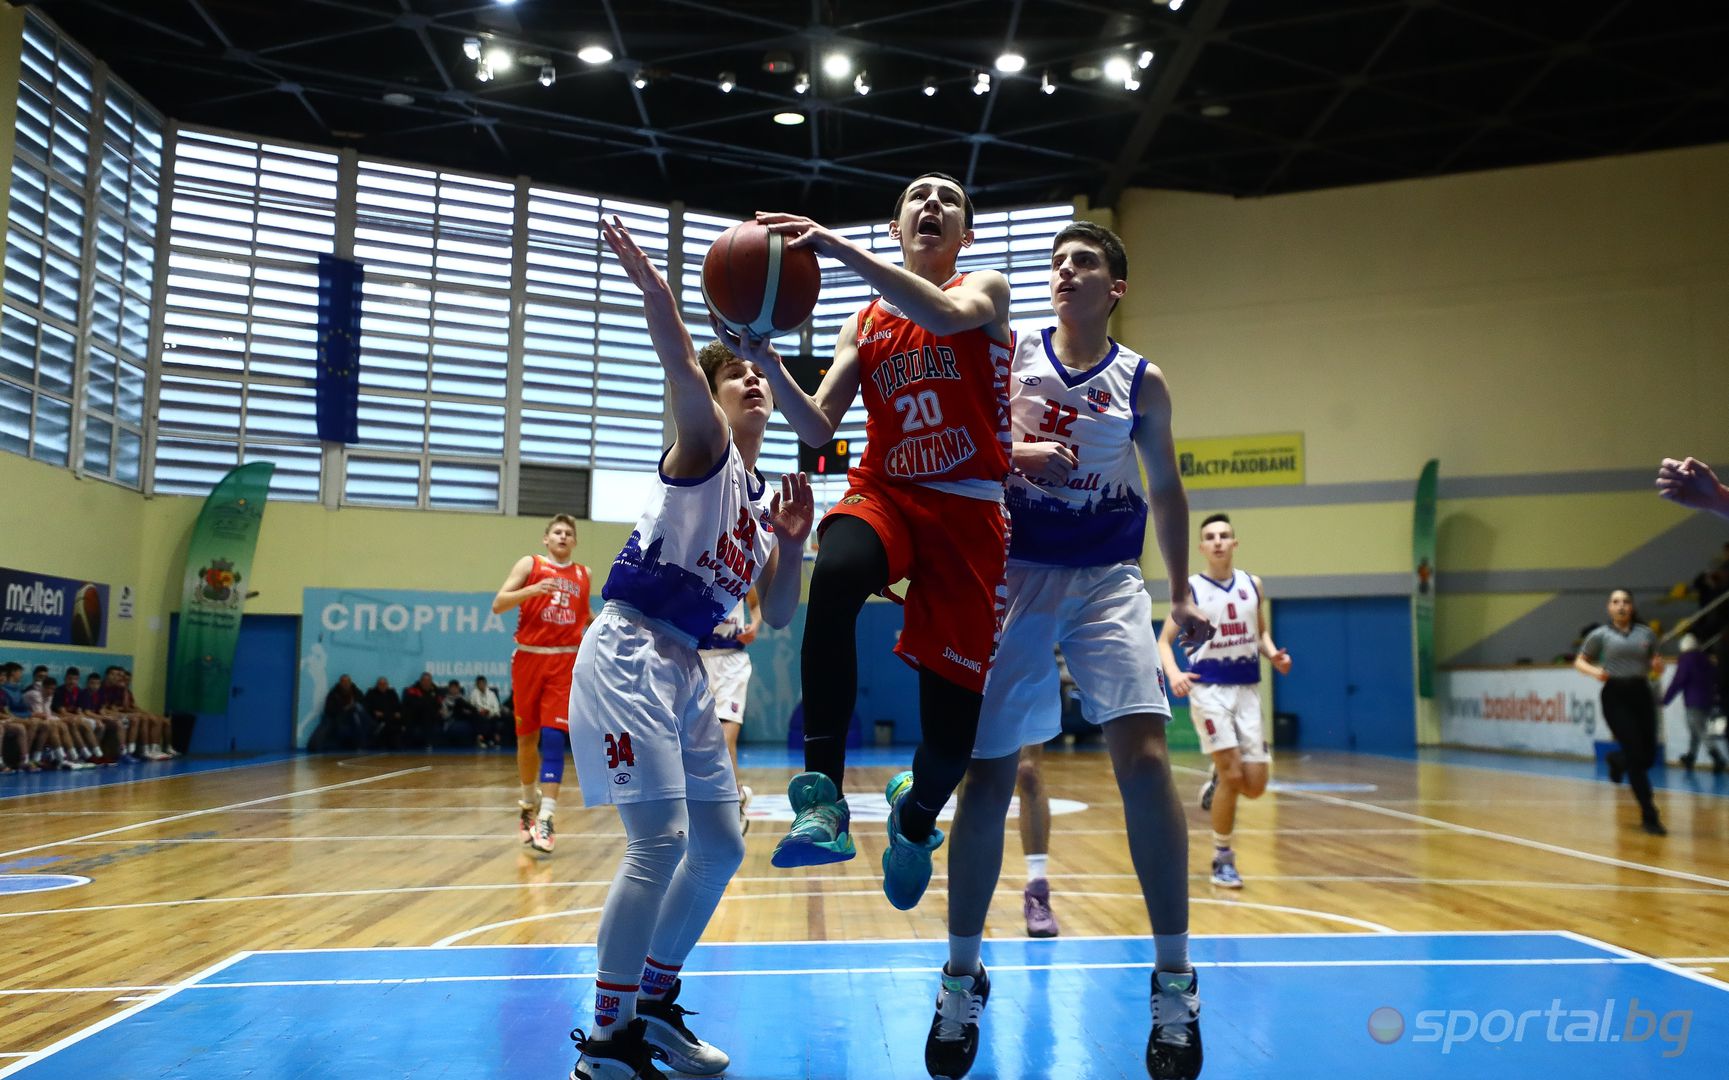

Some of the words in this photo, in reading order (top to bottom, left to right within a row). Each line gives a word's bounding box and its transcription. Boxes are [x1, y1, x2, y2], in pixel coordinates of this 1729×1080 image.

[871, 345, 961, 405] VARDAR
[894, 389, 944, 434] 20
[1039, 399, 1078, 437] 32
[836, 440, 848, 455] 0
[884, 426, 977, 478] CEVITANA
[733, 505, 757, 551] 34
[716, 532, 756, 585] BUBA
[6, 581, 64, 616] molten
[551, 591, 570, 607] 35
[321, 603, 506, 633] СПОРТНА
[942, 646, 982, 674] SPALDING
[605, 732, 634, 768] 34
